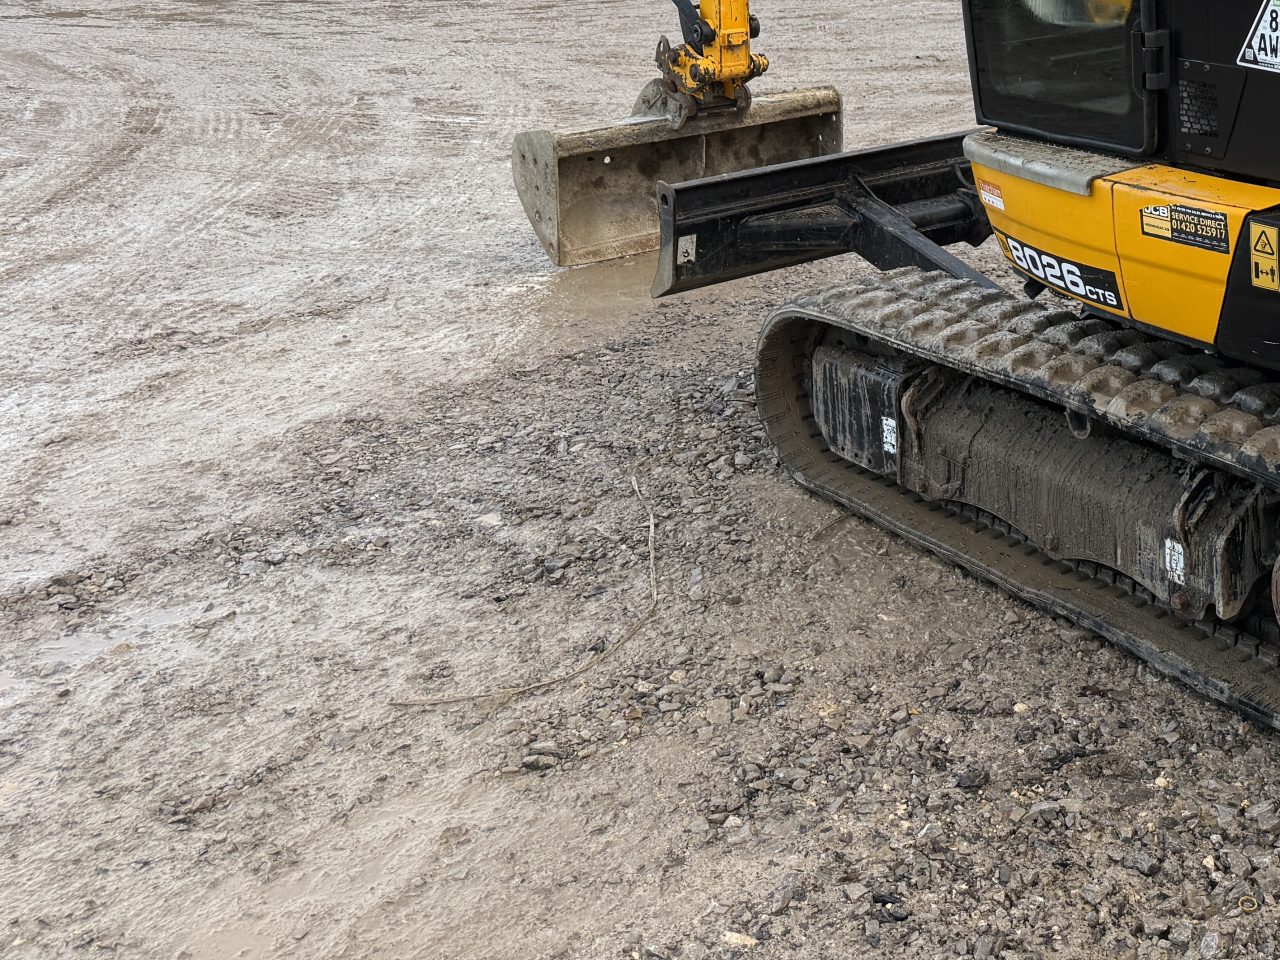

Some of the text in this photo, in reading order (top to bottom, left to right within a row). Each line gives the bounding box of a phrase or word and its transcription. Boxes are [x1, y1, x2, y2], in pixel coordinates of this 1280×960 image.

[1144, 205, 1168, 217] JCB
[1171, 211, 1225, 230] SERVICE DIRECT
[1172, 219, 1195, 233] 01420
[1197, 225, 1226, 239] 525917
[1007, 238, 1086, 295] 8026
[1085, 285, 1117, 306] CTS
